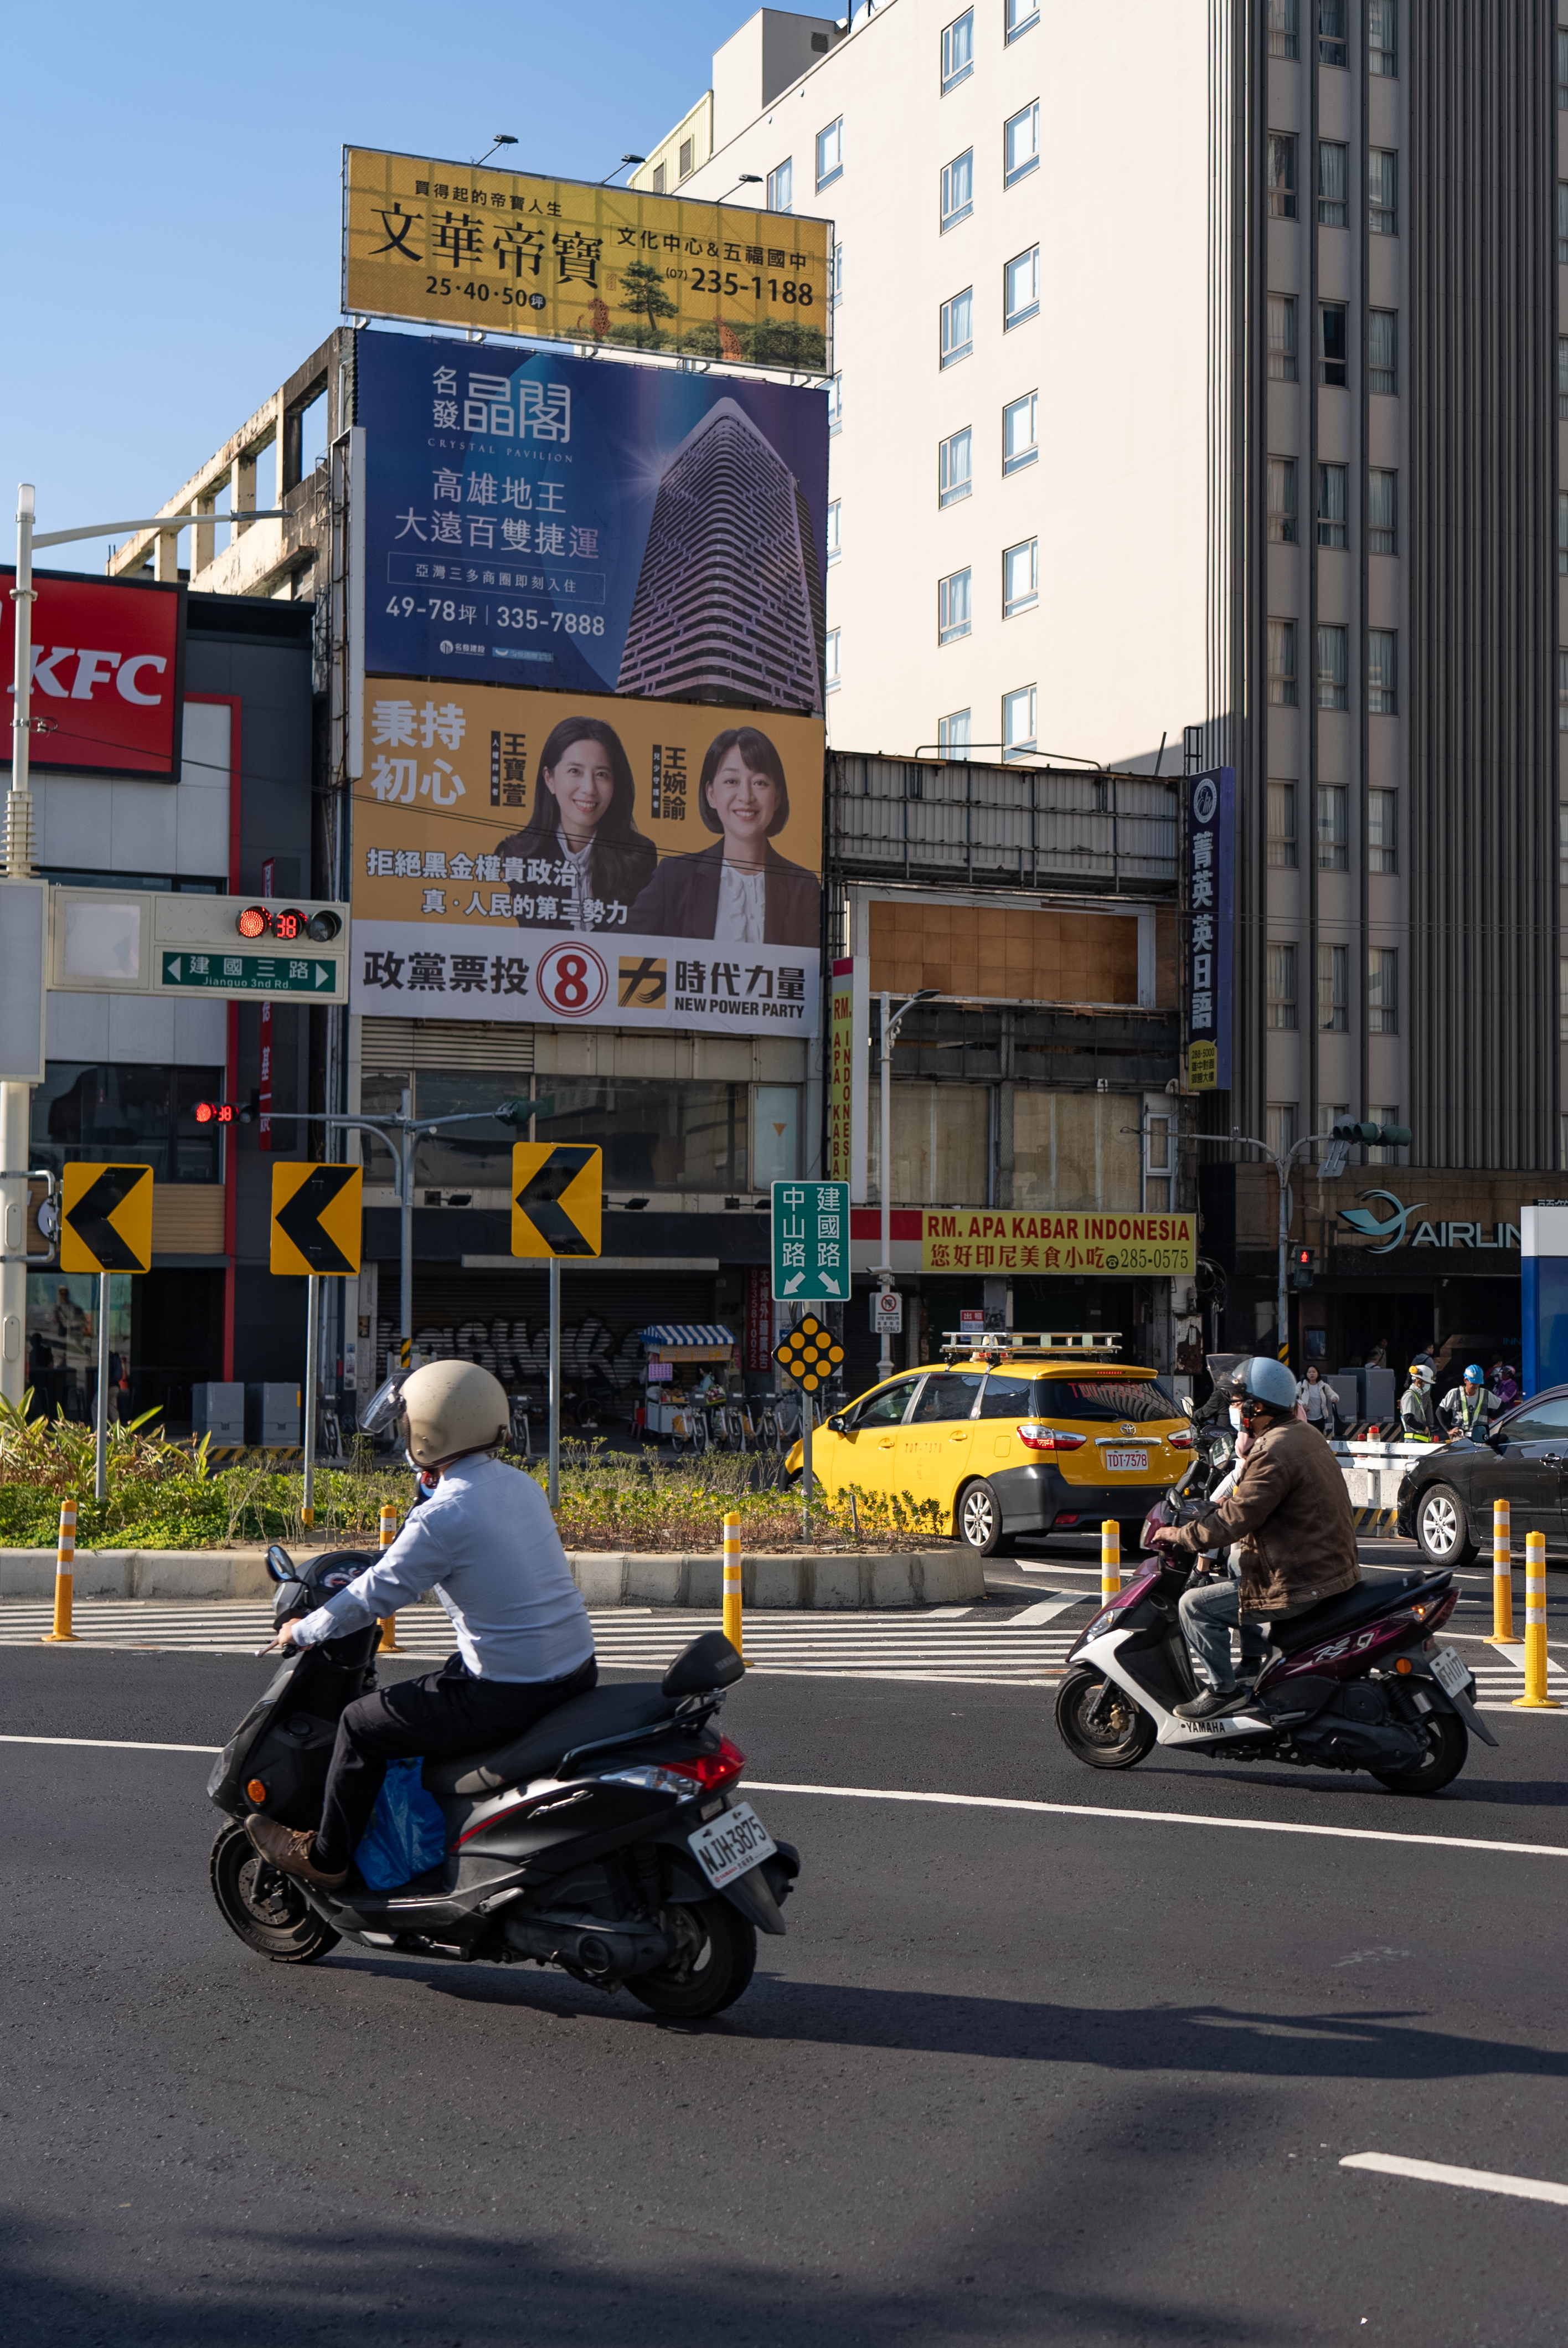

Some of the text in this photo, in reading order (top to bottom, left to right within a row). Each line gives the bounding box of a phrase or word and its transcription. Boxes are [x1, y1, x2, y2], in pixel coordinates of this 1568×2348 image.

[415, 180, 562, 217] 買得起的帝寶人生
[369, 202, 604, 289] 文華帝寶
[617, 226, 807, 271] 文化中心&五福國中
[666, 267, 813, 306] (07) 235-1188
[464, 373, 570, 443] 晶閣
[428, 438, 573, 463] CRYSTAL PAVILION
[432, 468, 566, 513] 高雄地王
[394, 507, 599, 559] 大遠百雙捷運
[416, 564, 576, 593] 亞灣三多商圈即刻入住
[386, 596, 605, 636] 49-78坪 335-7888
[7, 645, 167, 706] KFC
[371, 700, 466, 750] 秉持
[370, 755, 466, 806] 初心
[503, 733, 527, 807] 王寶萱
[663, 746, 687, 821] 王婉諭
[367, 848, 580, 888] 拒絕黑金權貴政治
[277, 915, 296, 938] 38
[189, 956, 309, 981] 建國三路
[203, 976, 292, 990] Jianguo 3nd Rd.
[363, 950, 530, 995] 政黨票投
[556, 954, 589, 1007] 8
[675, 960, 806, 1001] 時代力量
[674, 997, 805, 1019] NEW POWER PARTY
[834, 997, 852, 1020] RM.
[782, 1187, 806, 1267] 中山路
[817, 1187, 840, 1267] 建國路
[928, 1216, 1190, 1241] RM. APA KABAR INDONESIA
[931, 1244, 1188, 1269] 您好印尼美食小吃 285-0575
[1107, 1454, 1147, 1467] TDT-7378
[1186, 1722, 1226, 1733] YAMAHA
[698, 1816, 766, 1875] NJH-3875
